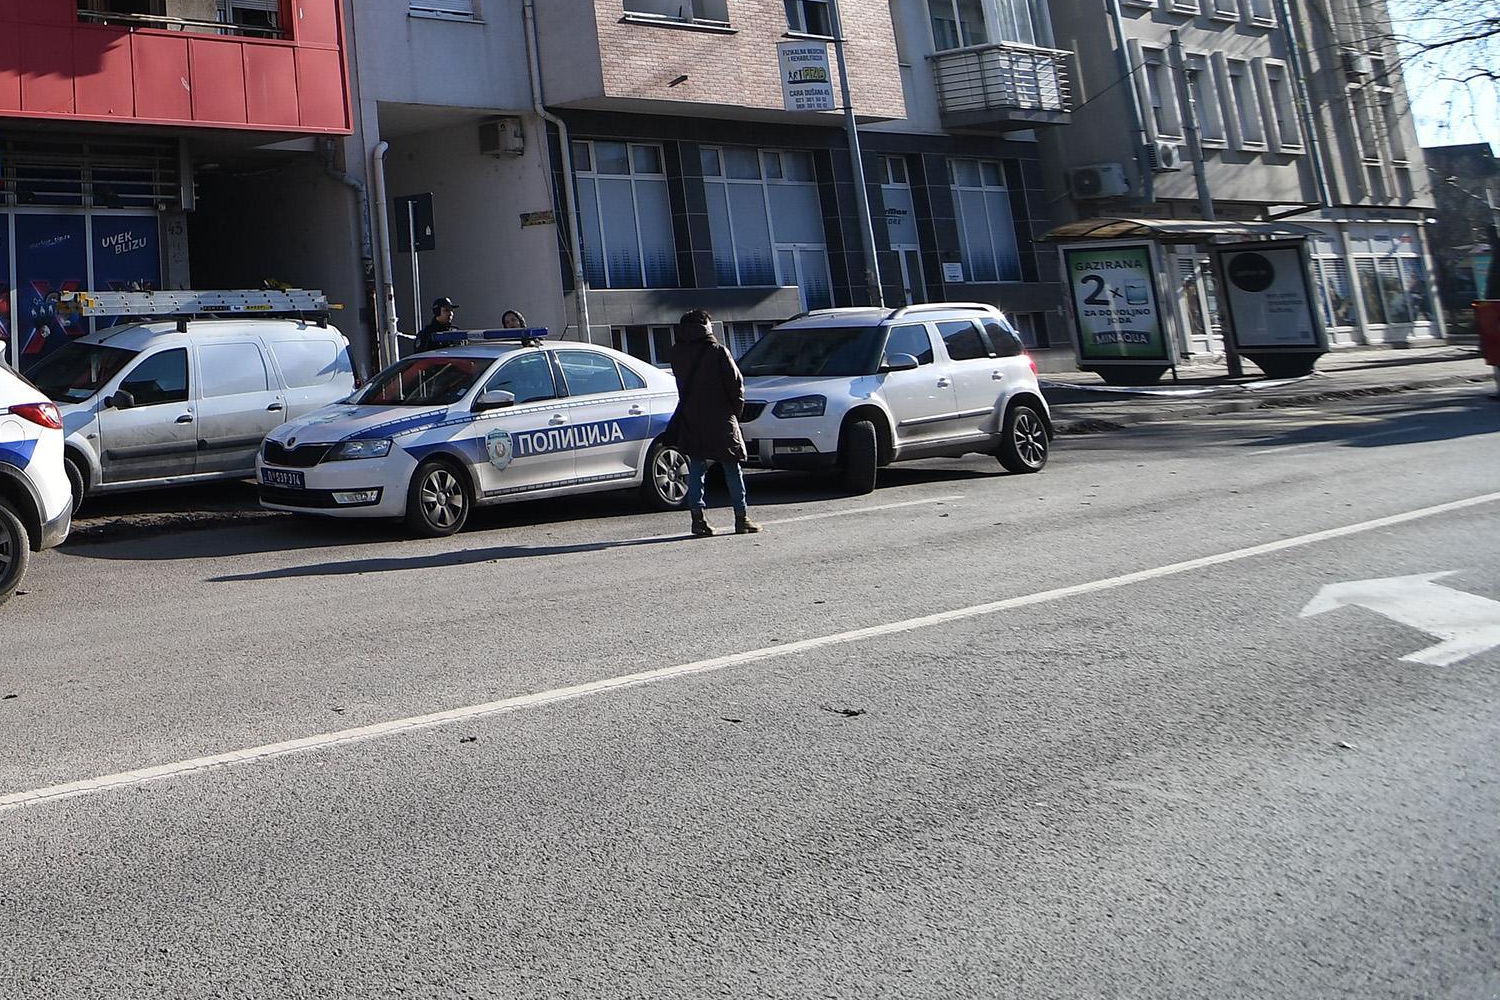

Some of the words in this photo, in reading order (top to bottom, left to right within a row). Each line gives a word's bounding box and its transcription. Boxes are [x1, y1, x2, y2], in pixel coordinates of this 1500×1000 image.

[102, 231, 133, 248] UVEK
[115, 237, 148, 255] BLIZU
[1076, 259, 1144, 271] GAZIRANA
[1080, 274, 1110, 306] 2
[518, 421, 625, 455] ПОЛИЦИЈА
